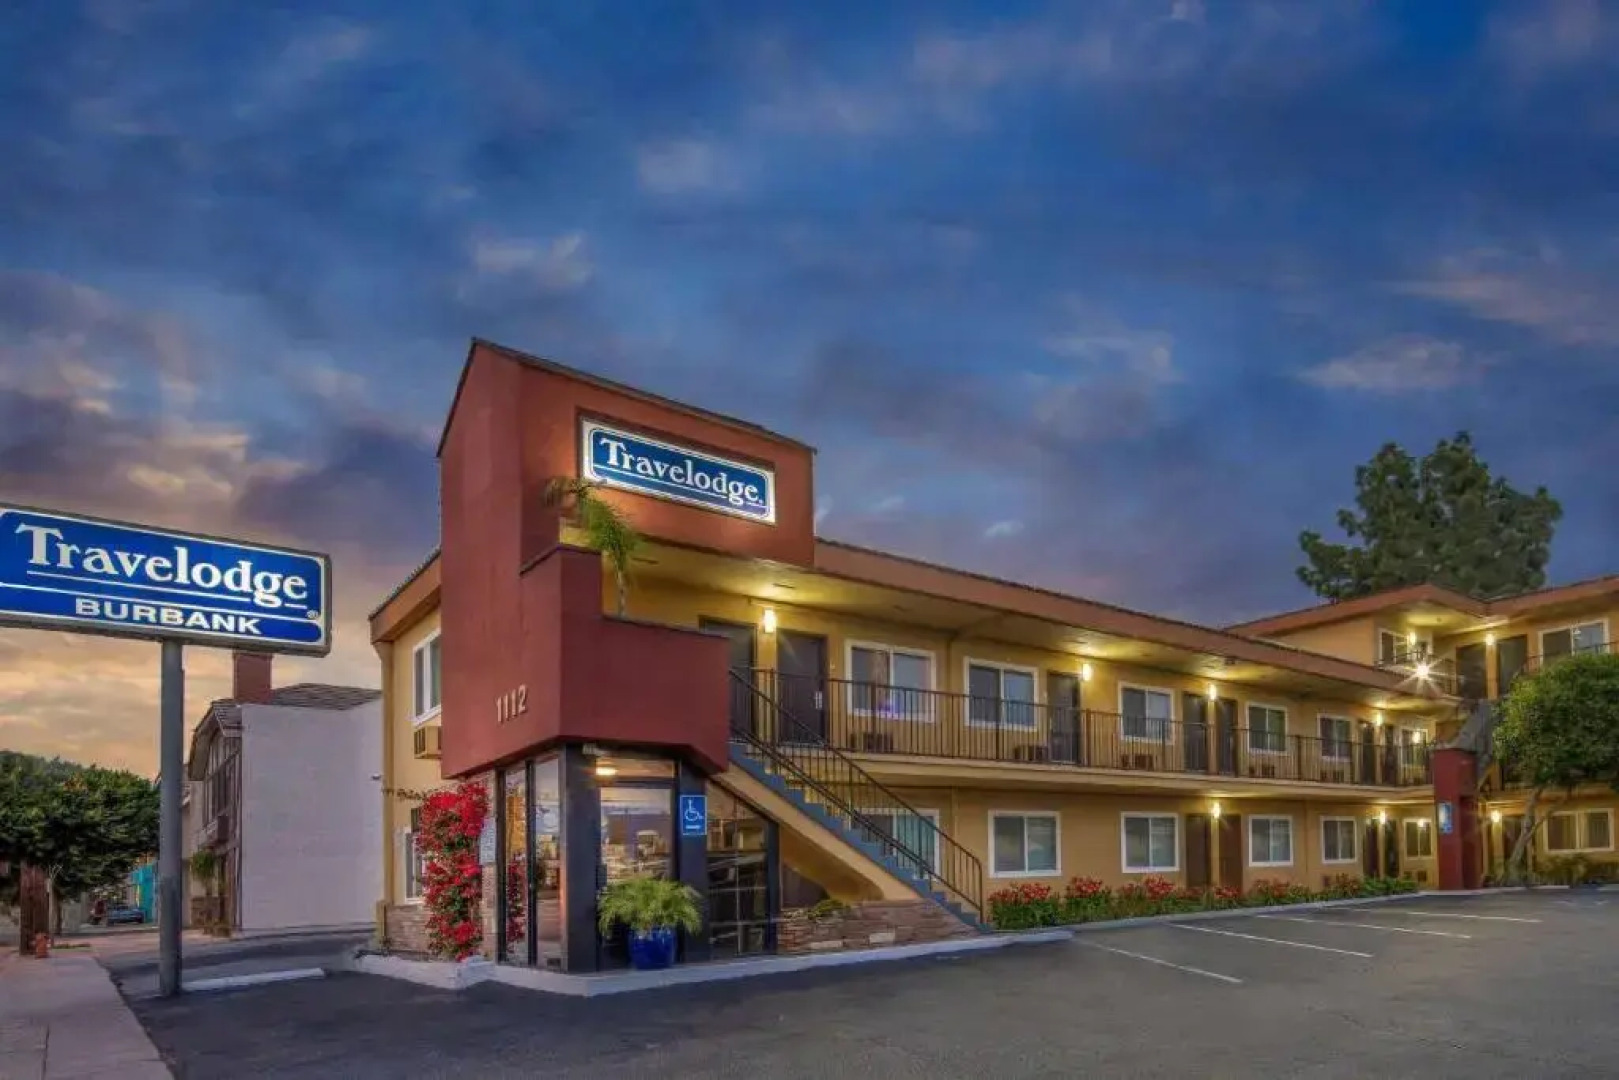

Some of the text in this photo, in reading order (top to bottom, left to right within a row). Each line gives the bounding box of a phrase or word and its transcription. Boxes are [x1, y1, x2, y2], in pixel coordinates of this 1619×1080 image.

[600, 438, 759, 505] Travelodge
[15, 523, 307, 607] Travelodge
[75, 598, 261, 634] BURBANK
[495, 684, 526, 722] 1112
